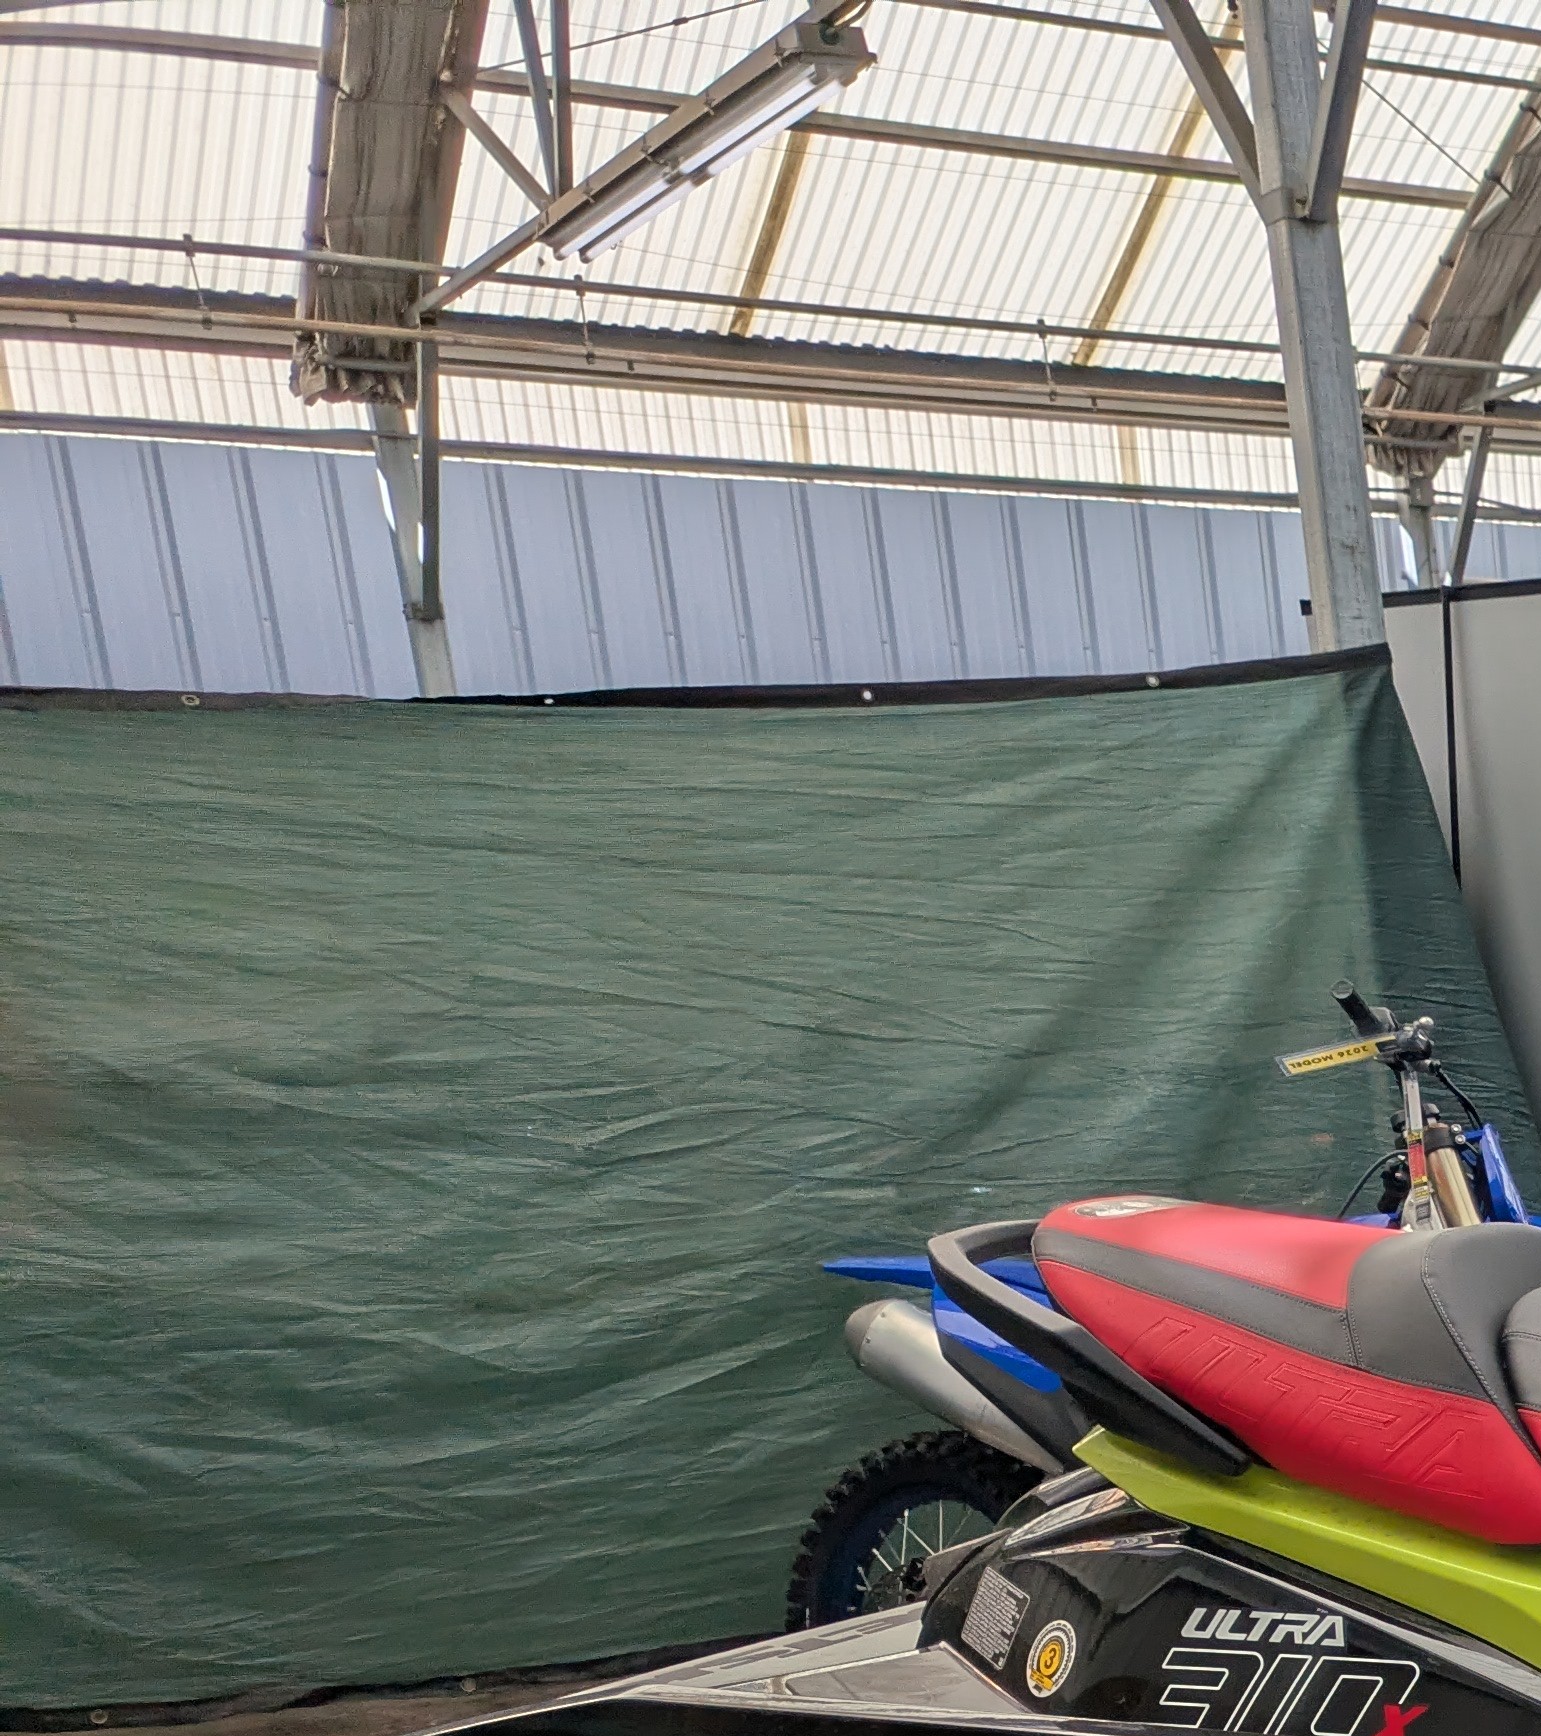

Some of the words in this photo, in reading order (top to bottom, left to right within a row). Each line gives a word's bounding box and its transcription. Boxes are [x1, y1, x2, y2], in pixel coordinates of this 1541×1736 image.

[1289, 1054, 1334, 1069] MODEL
[1180, 1607, 1346, 1648] ULTRA
[1044, 1647, 1057, 1670] 3
